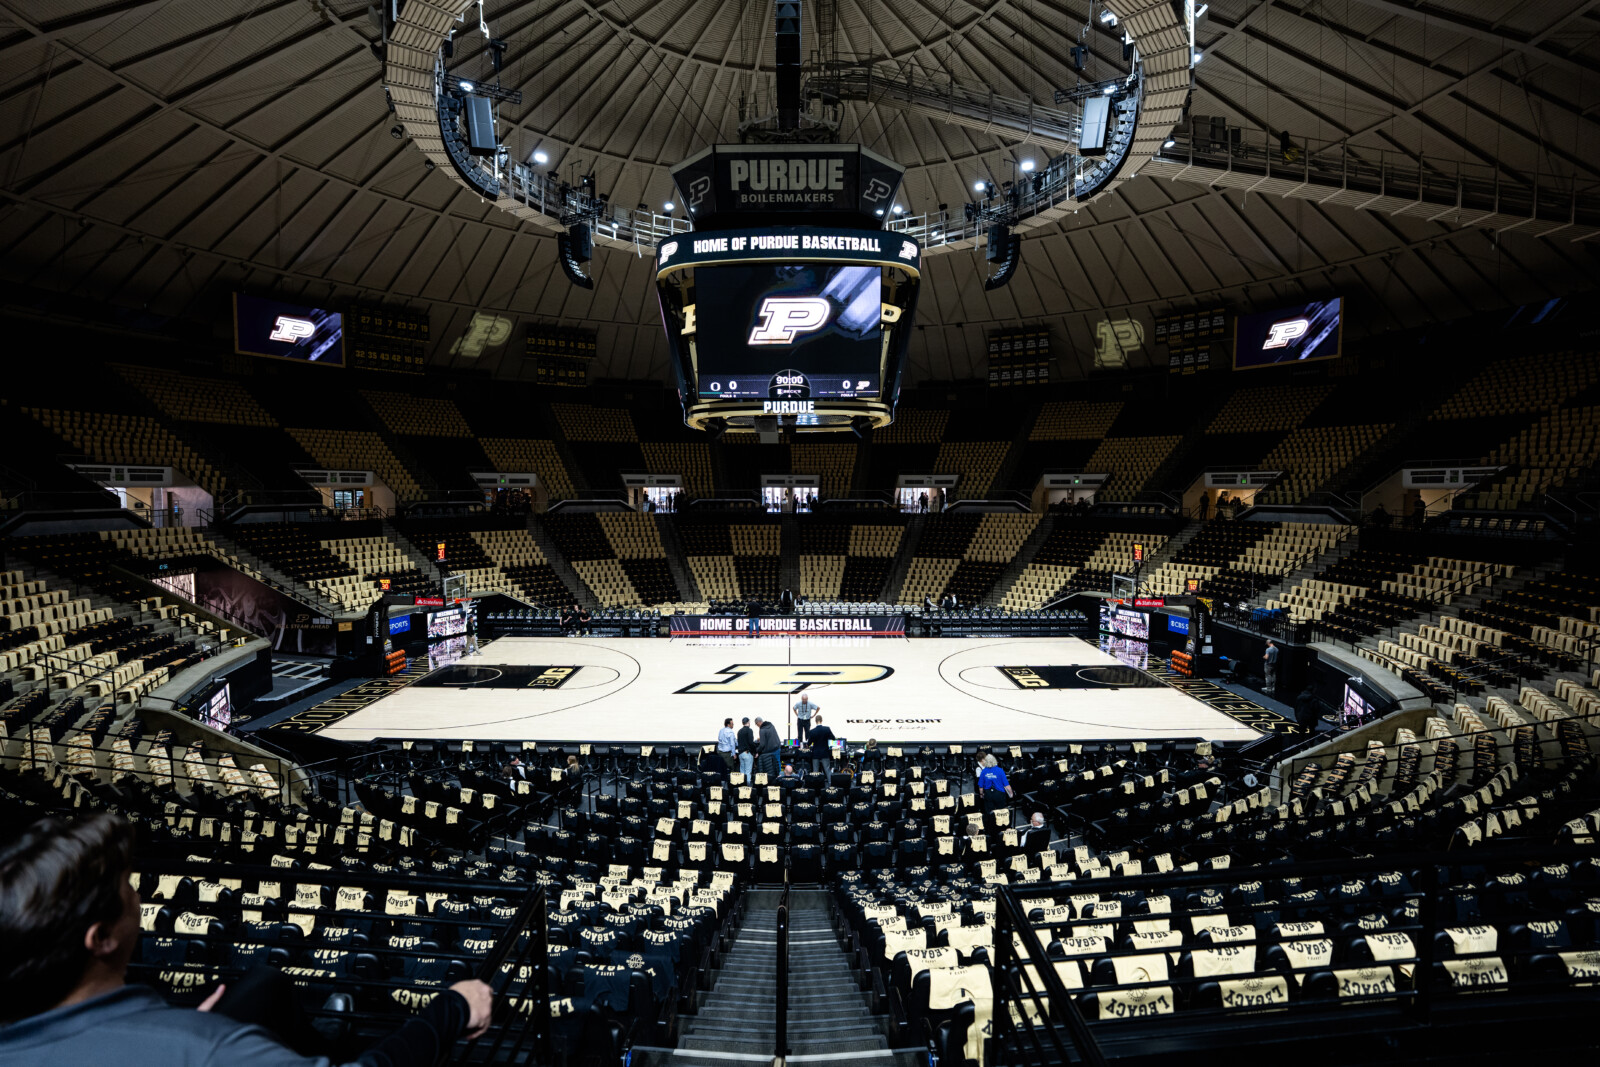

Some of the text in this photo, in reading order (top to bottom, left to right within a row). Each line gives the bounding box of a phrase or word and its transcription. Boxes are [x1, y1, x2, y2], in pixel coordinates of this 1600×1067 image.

[730, 159, 843, 191] PURDUE
[863, 178, 891, 203] P
[741, 193, 834, 203] BOILERMAKERS
[694, 236, 881, 253] HOME OF PURDUE BASKETBALL
[747, 297, 831, 345] P
[269, 316, 316, 344] P
[1262, 319, 1309, 350] P
[1094, 318, 1145, 367] P
[729, 380, 737, 390] 0
[776, 376, 803, 385] 90:00
[842, 380, 851, 390] 0
[763, 401, 815, 413] PURDUE
[700, 619, 732, 631] HOME
[735, 619, 750, 630] OF
[800, 618, 872, 631] BASKETBALL
[671, 663, 895, 695] P
[441, 900, 470, 911] LEGACY
[678, 906, 706, 916] LEGACY
[1096, 901, 1119, 911] EGACY
[549, 912, 579, 923] LEGACY
[604, 914, 637, 924] LEGACY
[664, 918, 695, 928] LEGACY
[879, 917, 900, 926] EGAC
[1282, 922, 1316, 932] EGACY
[1527, 920, 1562, 934] EGACY
[580, 928, 616, 942] LEGACY
[643, 929, 677, 943] LEGACY
[1134, 931, 1173, 939] EGACY
[1370, 932, 1408, 944] EGAC
[1061, 936, 1102, 947] LEGACY
[1288, 939, 1334, 955] LEGACY
[1342, 974, 1396, 996] LEGACY
[1224, 985, 1284, 1007] LEGACY
[1105, 994, 1170, 1017] LEGACY
